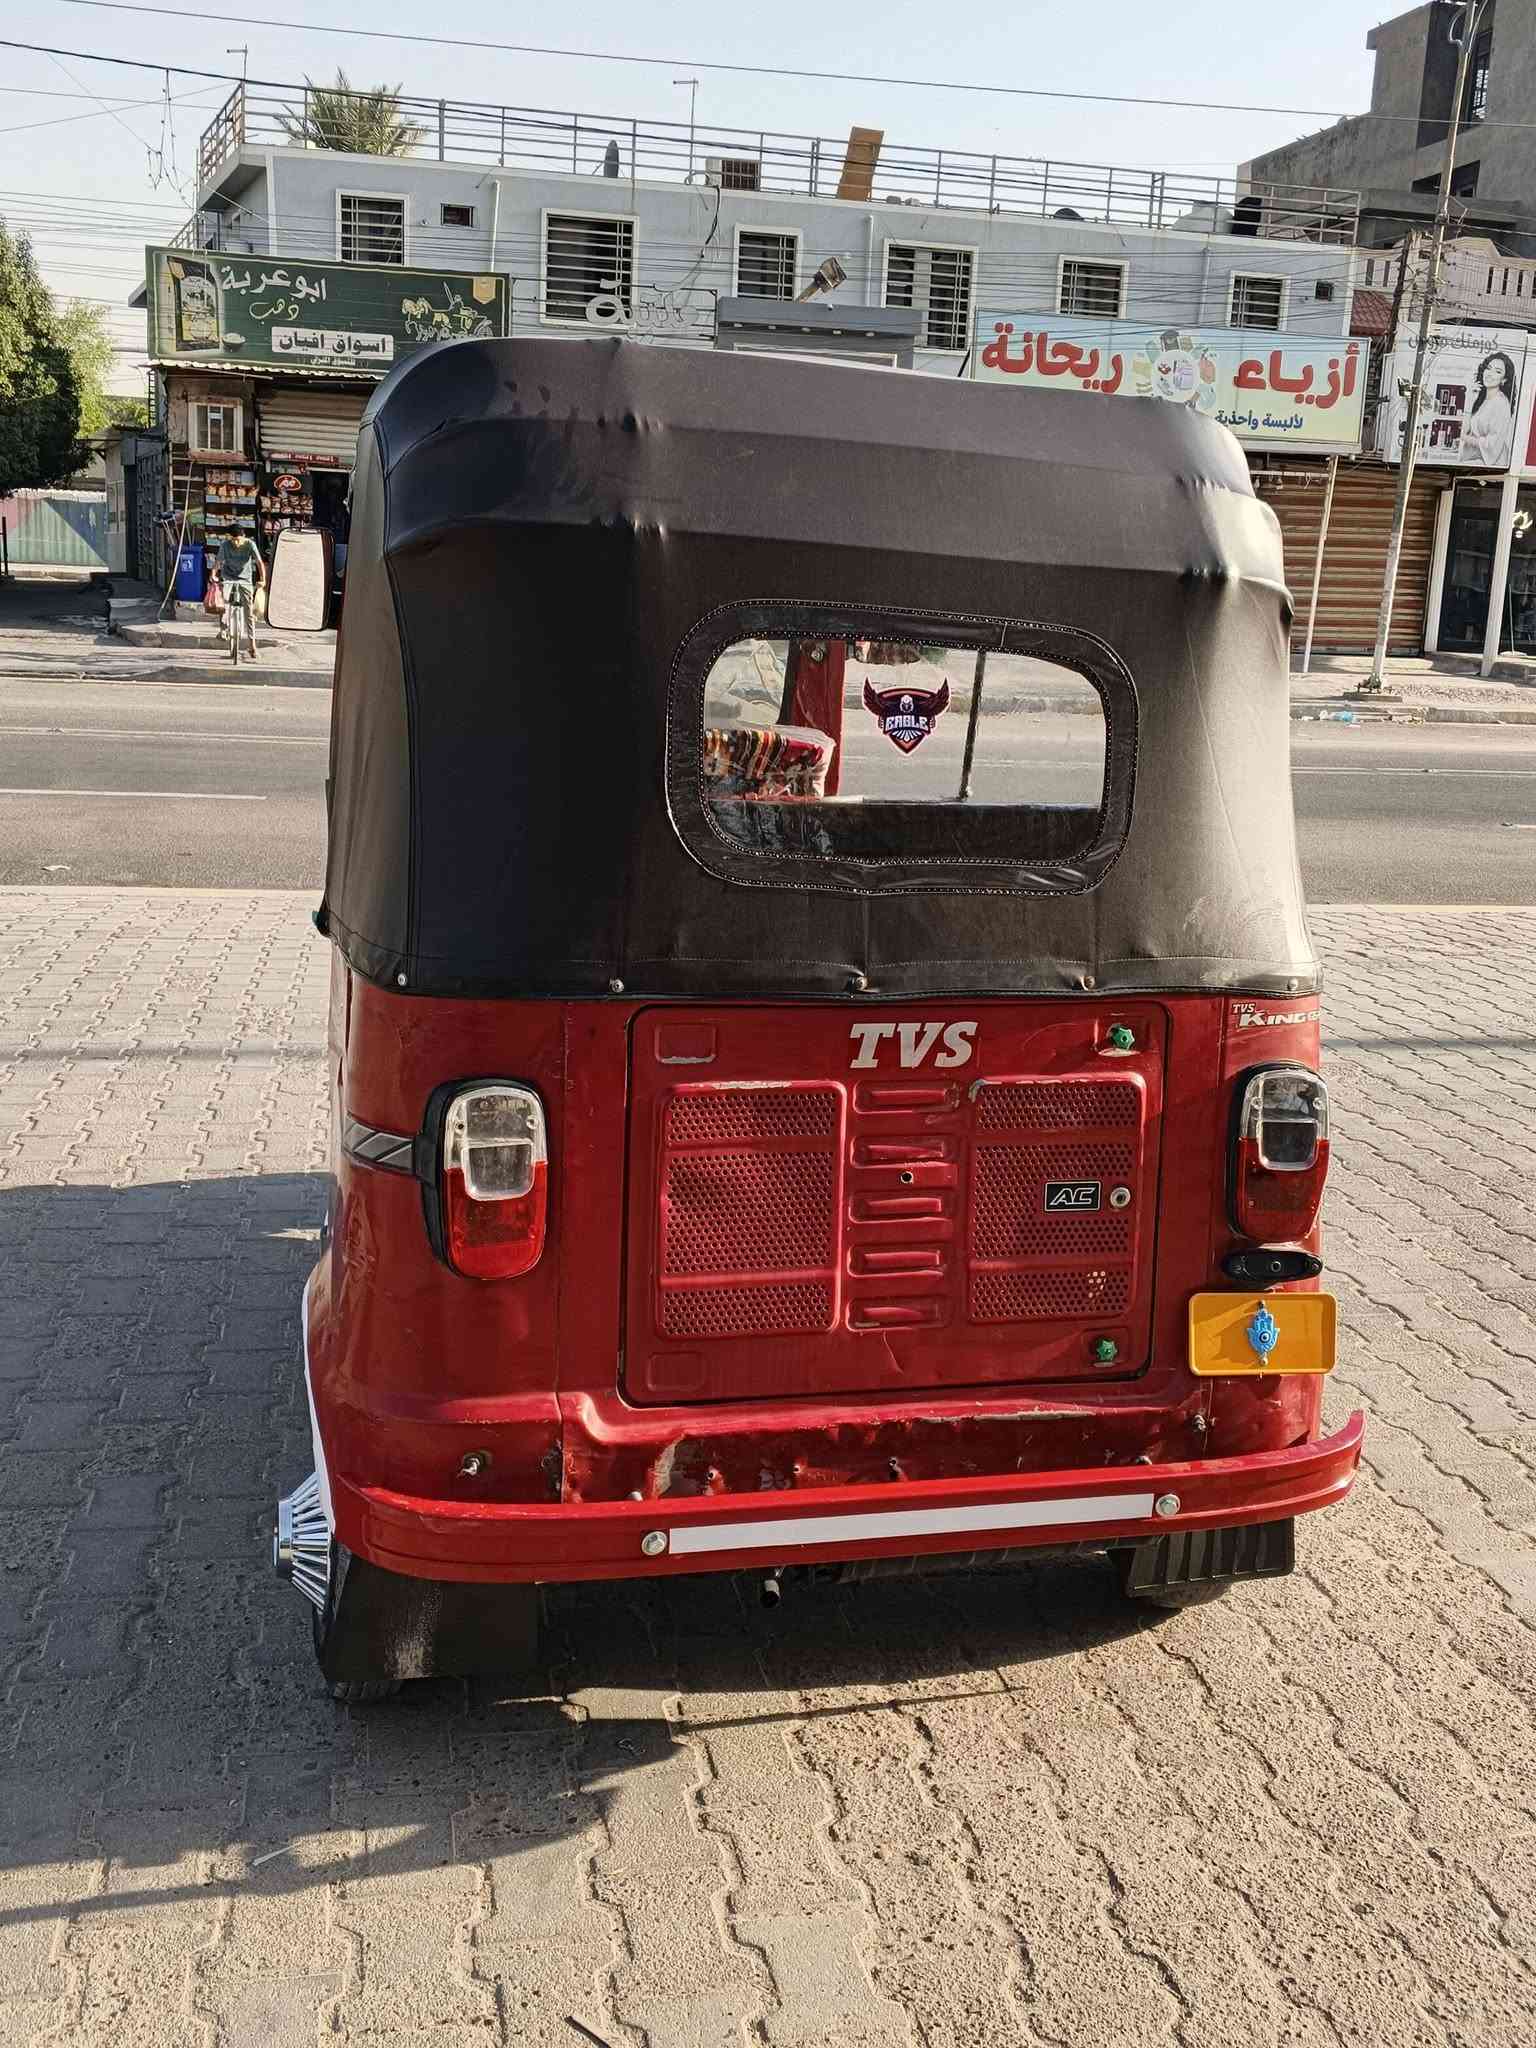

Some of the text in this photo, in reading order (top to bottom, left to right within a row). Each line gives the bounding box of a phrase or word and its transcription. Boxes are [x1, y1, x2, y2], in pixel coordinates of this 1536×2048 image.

[332, 334, 386, 355] اسواق
[982, 322, 1361, 409] أزياء ريحانة
[886, 714, 929, 732] EAGLE
[1232, 1003, 1256, 1014] TVS
[850, 1021, 979, 1069] TVS
[1049, 1187, 1097, 1206] AC
